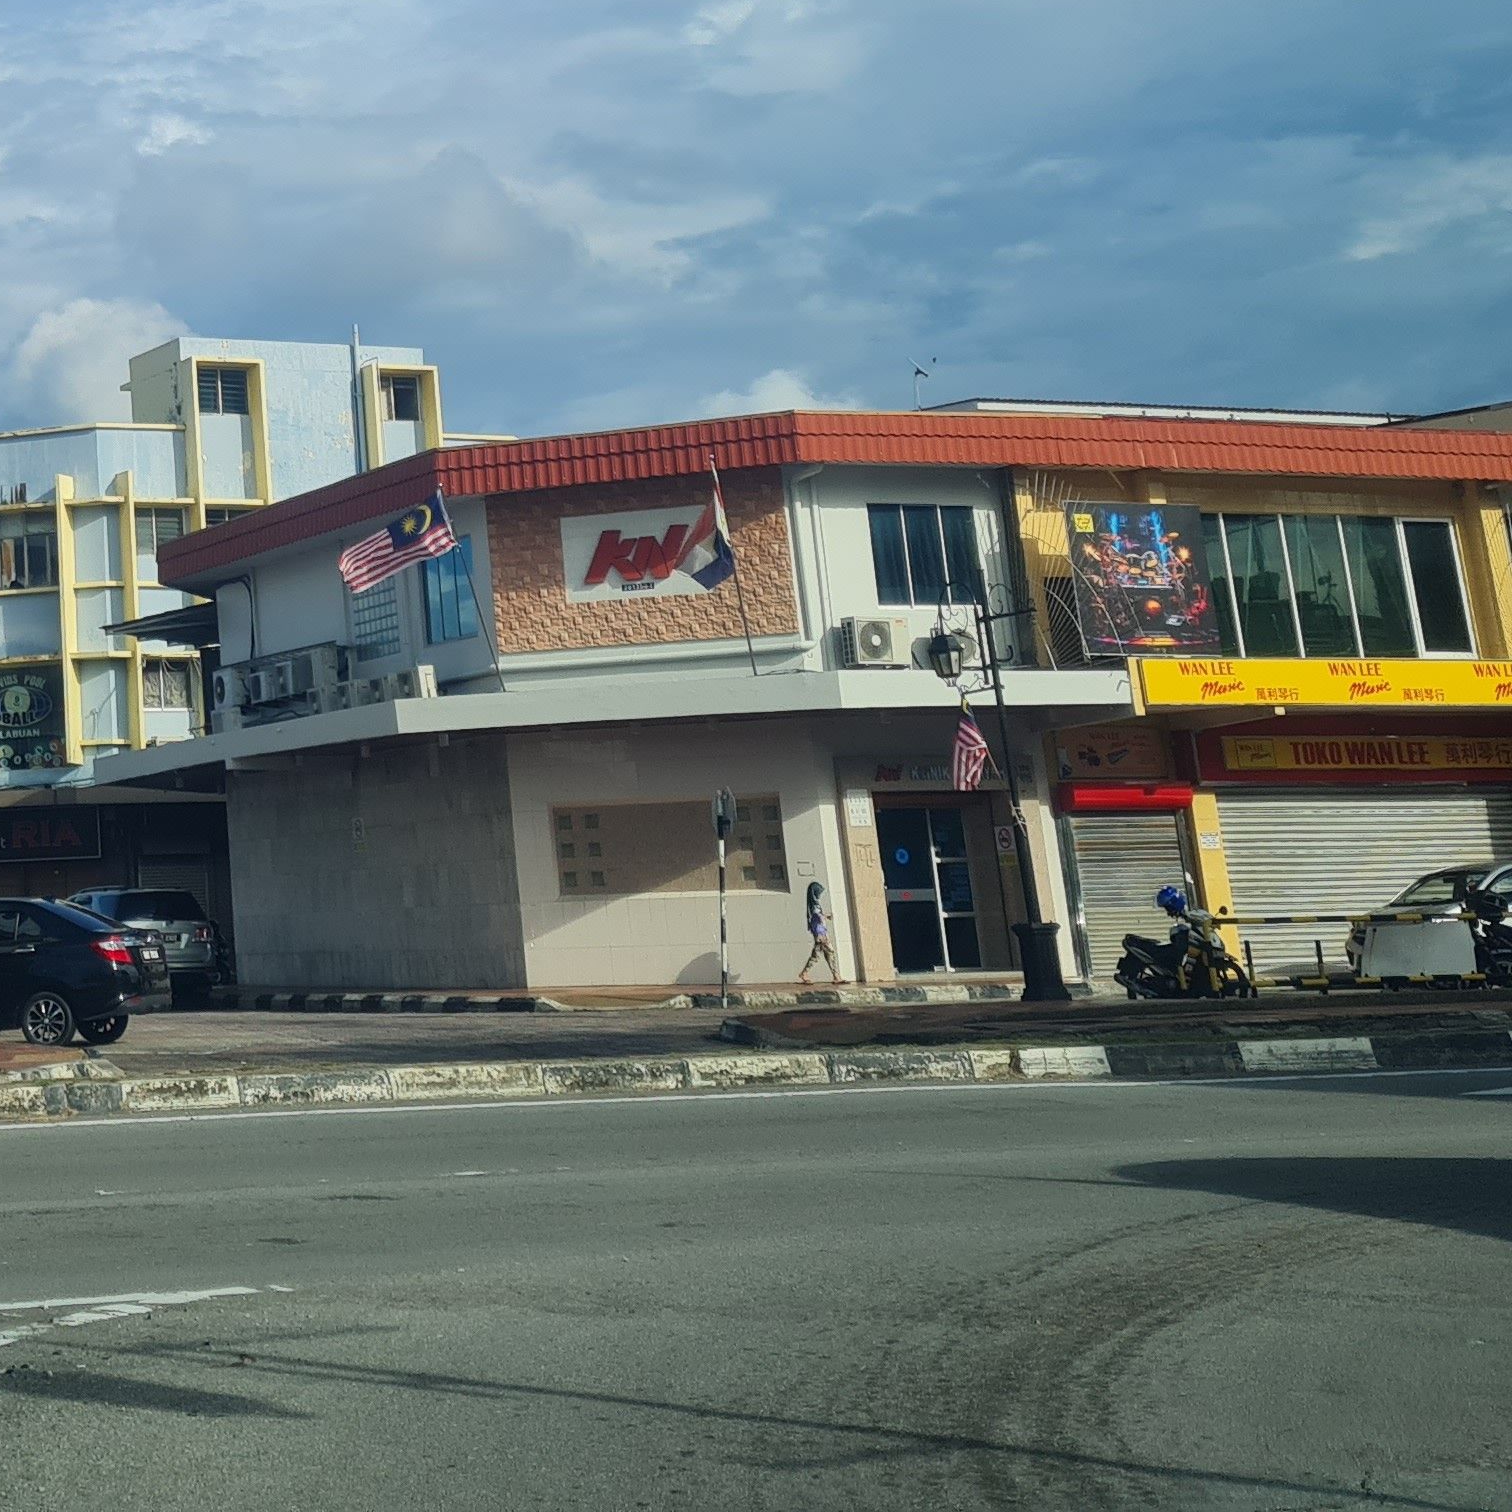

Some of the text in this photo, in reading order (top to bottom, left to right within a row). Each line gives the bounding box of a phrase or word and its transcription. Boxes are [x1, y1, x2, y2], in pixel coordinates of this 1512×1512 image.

[1179, 662, 1236, 675] WAN LEE
[1327, 662, 1383, 676] WAN LEE
[1473, 664, 1501, 678] WAN
[1201, 679, 1245, 700] Music
[1349, 679, 1392, 700] Music
[2, 712, 37, 725] BALL
[1291, 741, 1431, 765] TOKO WAN LEE
